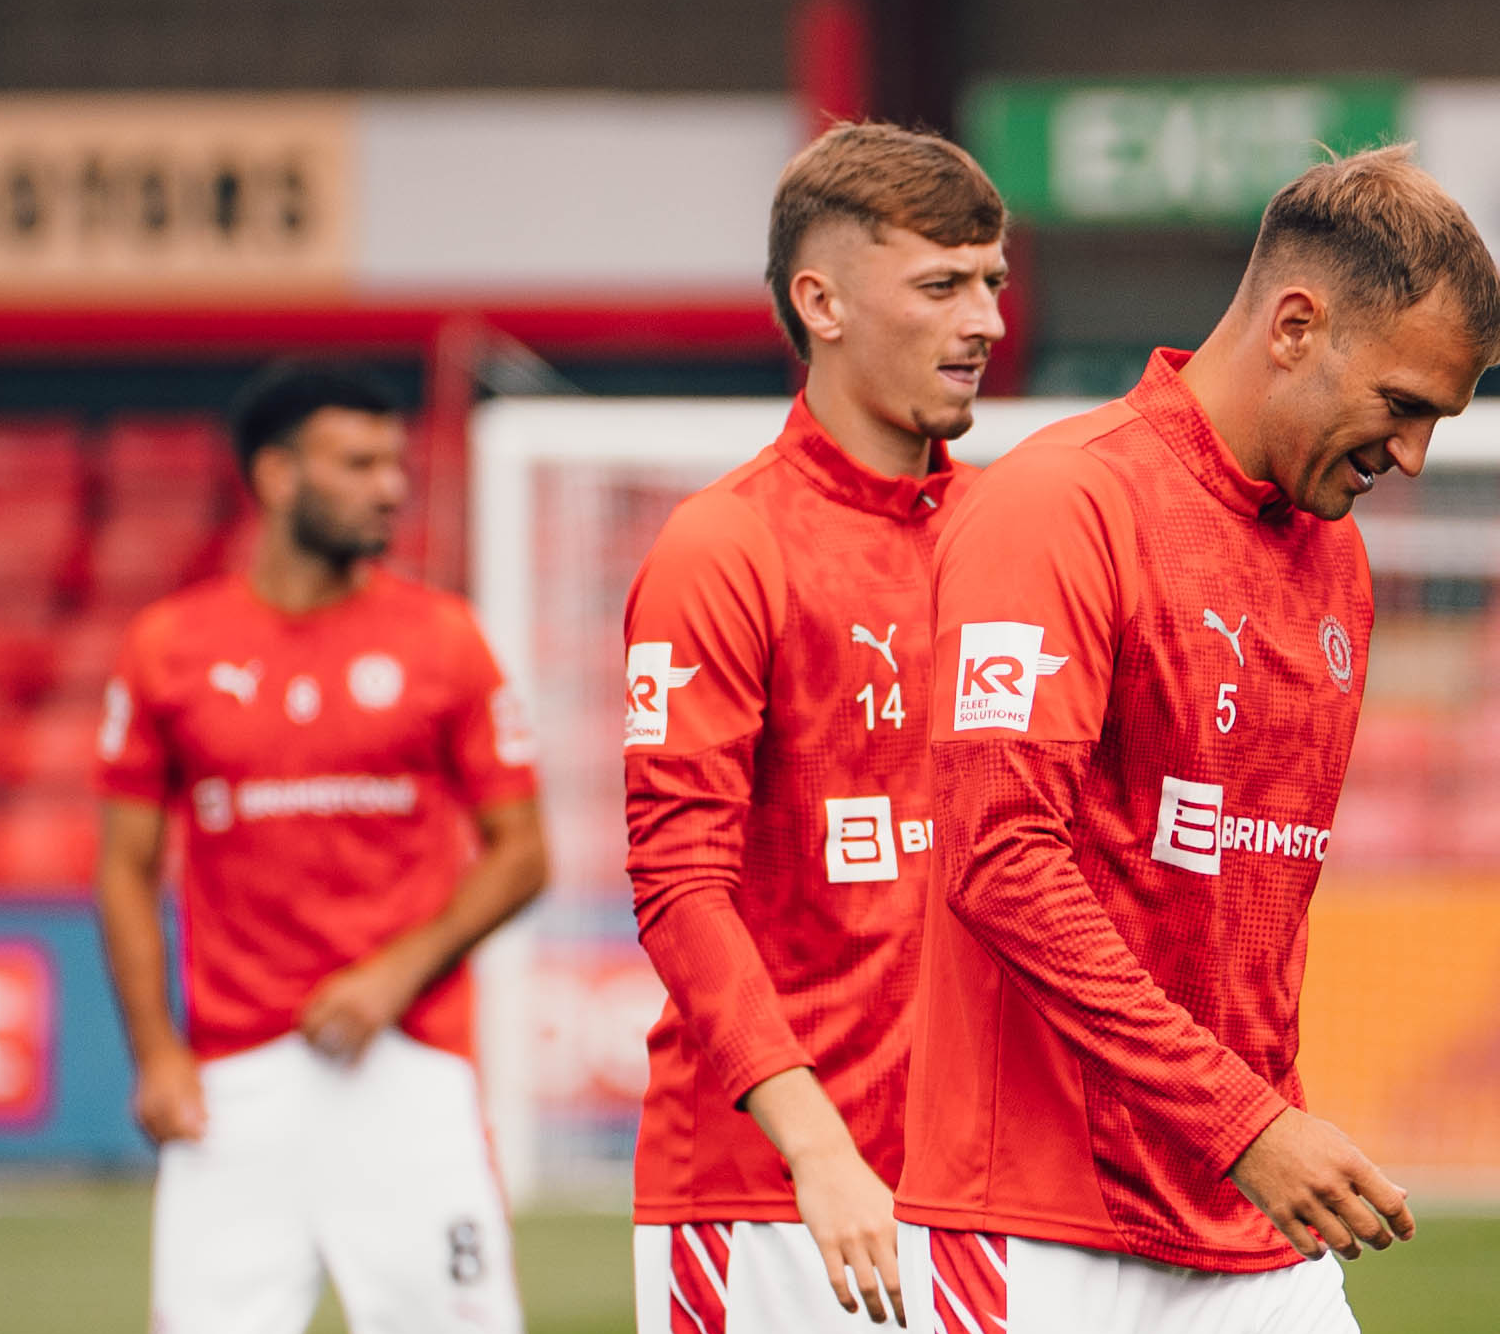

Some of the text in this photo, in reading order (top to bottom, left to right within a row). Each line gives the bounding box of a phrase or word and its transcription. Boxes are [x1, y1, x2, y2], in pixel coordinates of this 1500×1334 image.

[1053, 87, 1326, 219] EXIT
[962, 655, 1025, 697] KR
[856, 682, 906, 731] 14
[959, 709, 1026, 723] SOLUTIONS
[960, 698, 989, 711] FLEET
[1215, 682, 1238, 734] 5
[447, 1220, 486, 1284] 8
